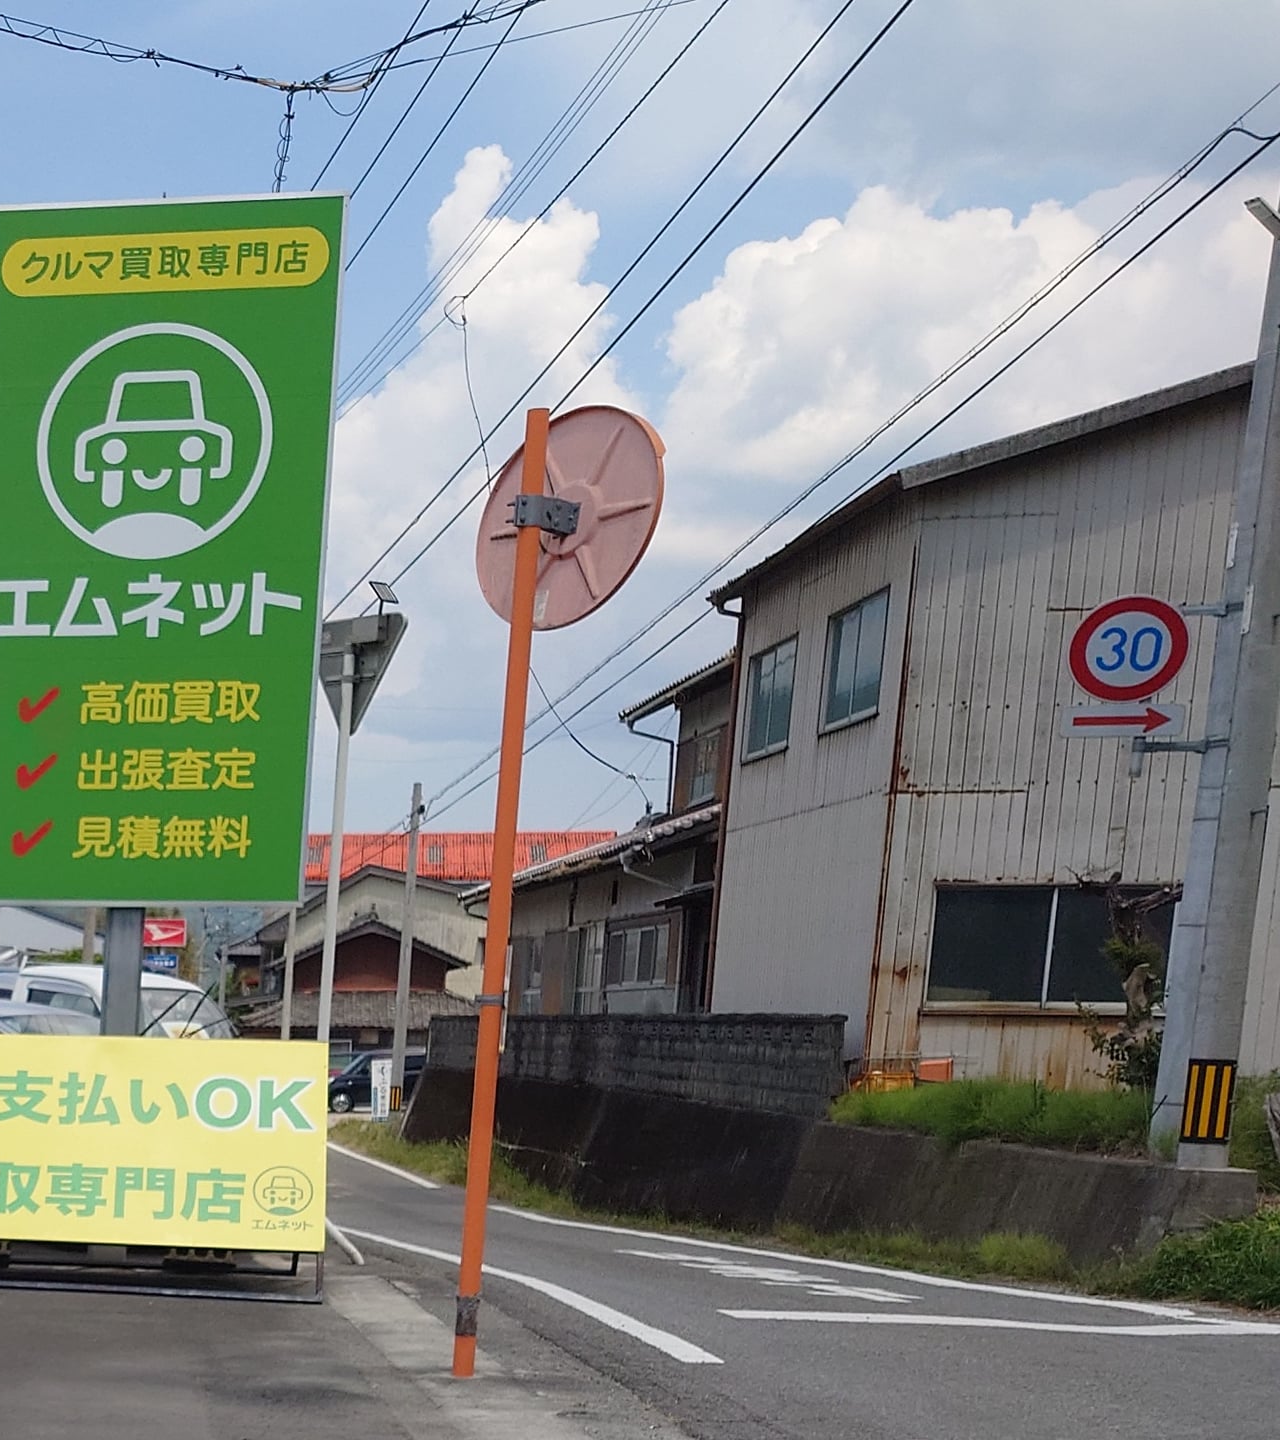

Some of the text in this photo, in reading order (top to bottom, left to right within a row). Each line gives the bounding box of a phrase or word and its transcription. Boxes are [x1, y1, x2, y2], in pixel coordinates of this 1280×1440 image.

[19, 239, 310, 284] クルマ買取専門店
[1095, 626, 1163, 672] 30
[78, 680, 261, 725] 高価買取
[76, 748, 257, 792] 出張査定
[71, 815, 252, 861] 見積無料
[251, 1219, 314, 1231] エムネット
